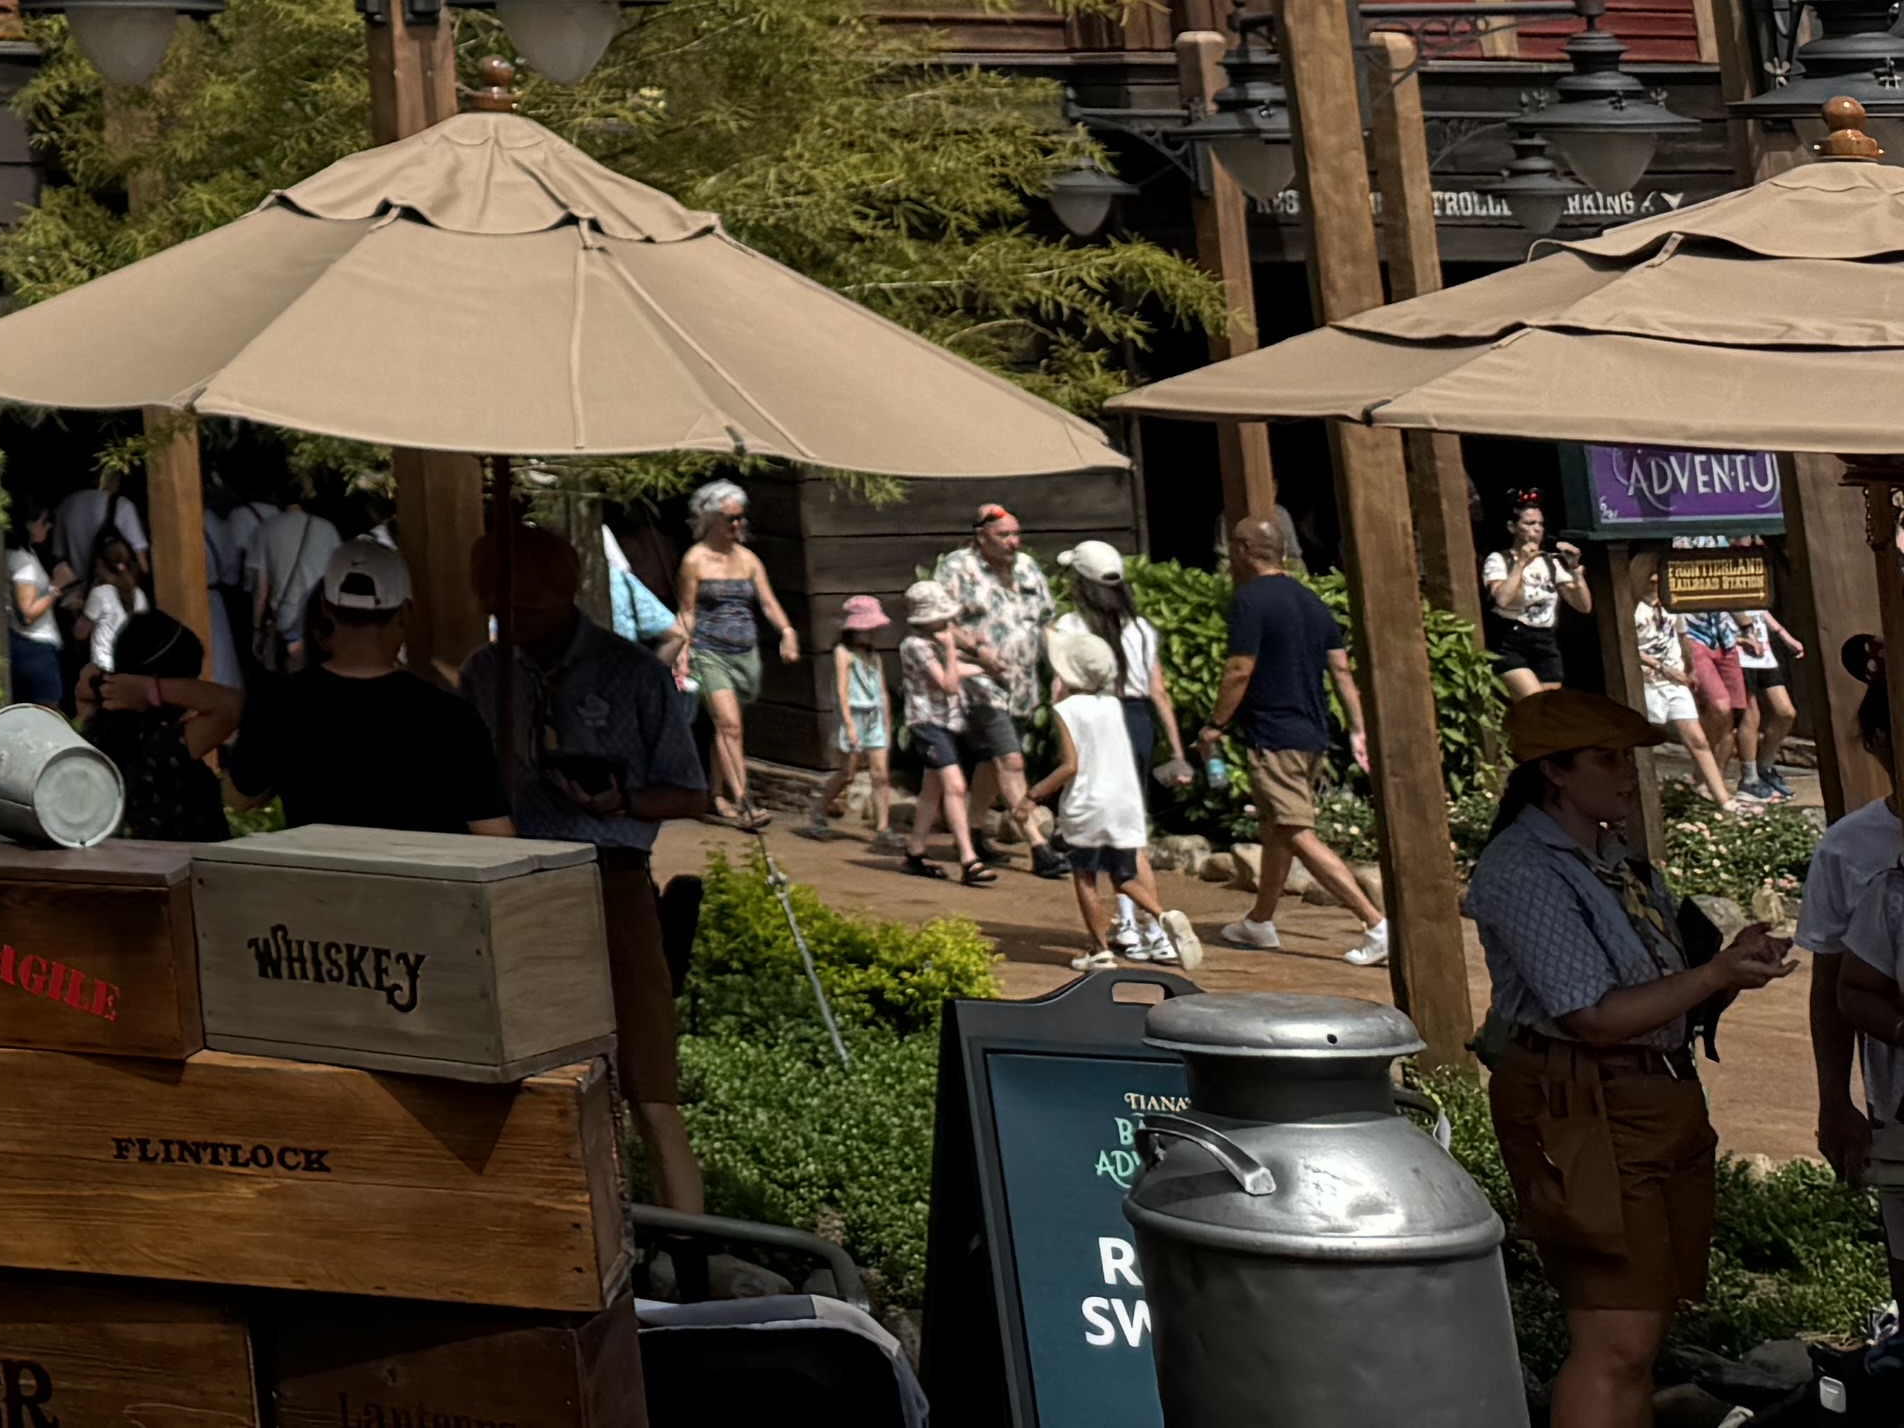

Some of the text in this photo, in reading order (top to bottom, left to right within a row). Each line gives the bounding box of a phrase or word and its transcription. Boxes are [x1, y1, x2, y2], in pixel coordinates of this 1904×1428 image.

[1432, 190, 1513, 216] TROLL
[1627, 453, 1780, 510] ADVENTU
[1667, 557, 1765, 578] FRONTIERLAND
[1721, 575, 1765, 590] STATION
[246, 923, 428, 1014] WHISKEY
[1123, 1091, 1191, 1112] TIANA'
[111, 1136, 332, 1174] FLINTLOCK
